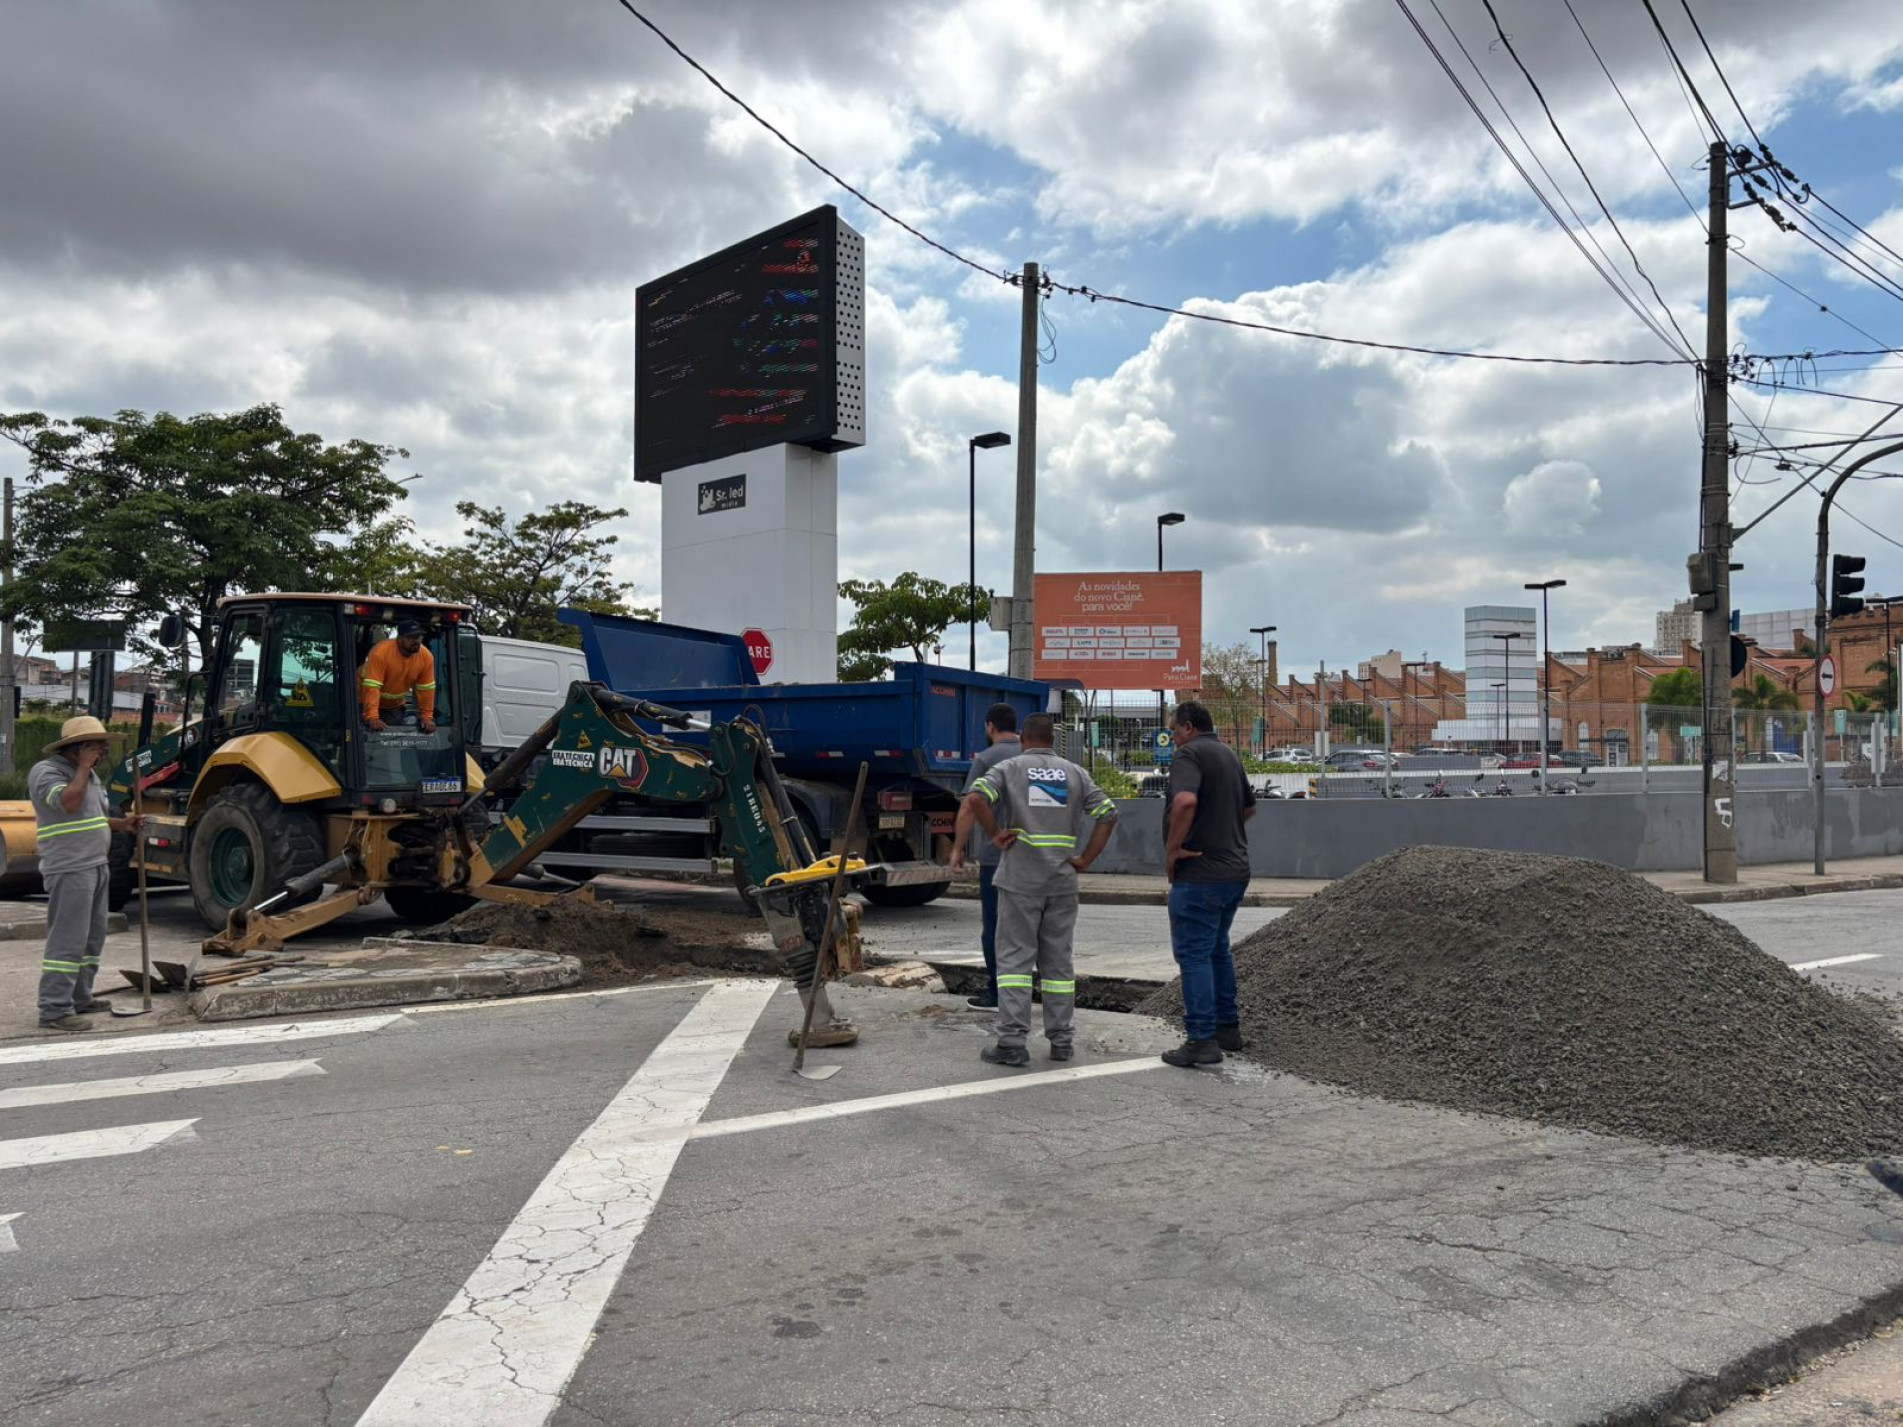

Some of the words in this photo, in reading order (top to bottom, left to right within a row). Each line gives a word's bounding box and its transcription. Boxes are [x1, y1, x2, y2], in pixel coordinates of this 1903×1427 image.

[1079, 581, 1093, 591] As
[1094, 580, 1141, 591] novidades
[1074, 591, 1087, 601] do
[1082, 603, 1104, 613] para
[747, 645, 770, 659] ARE
[600, 747, 636, 778] CAT
[1027, 767, 1067, 781] saae
